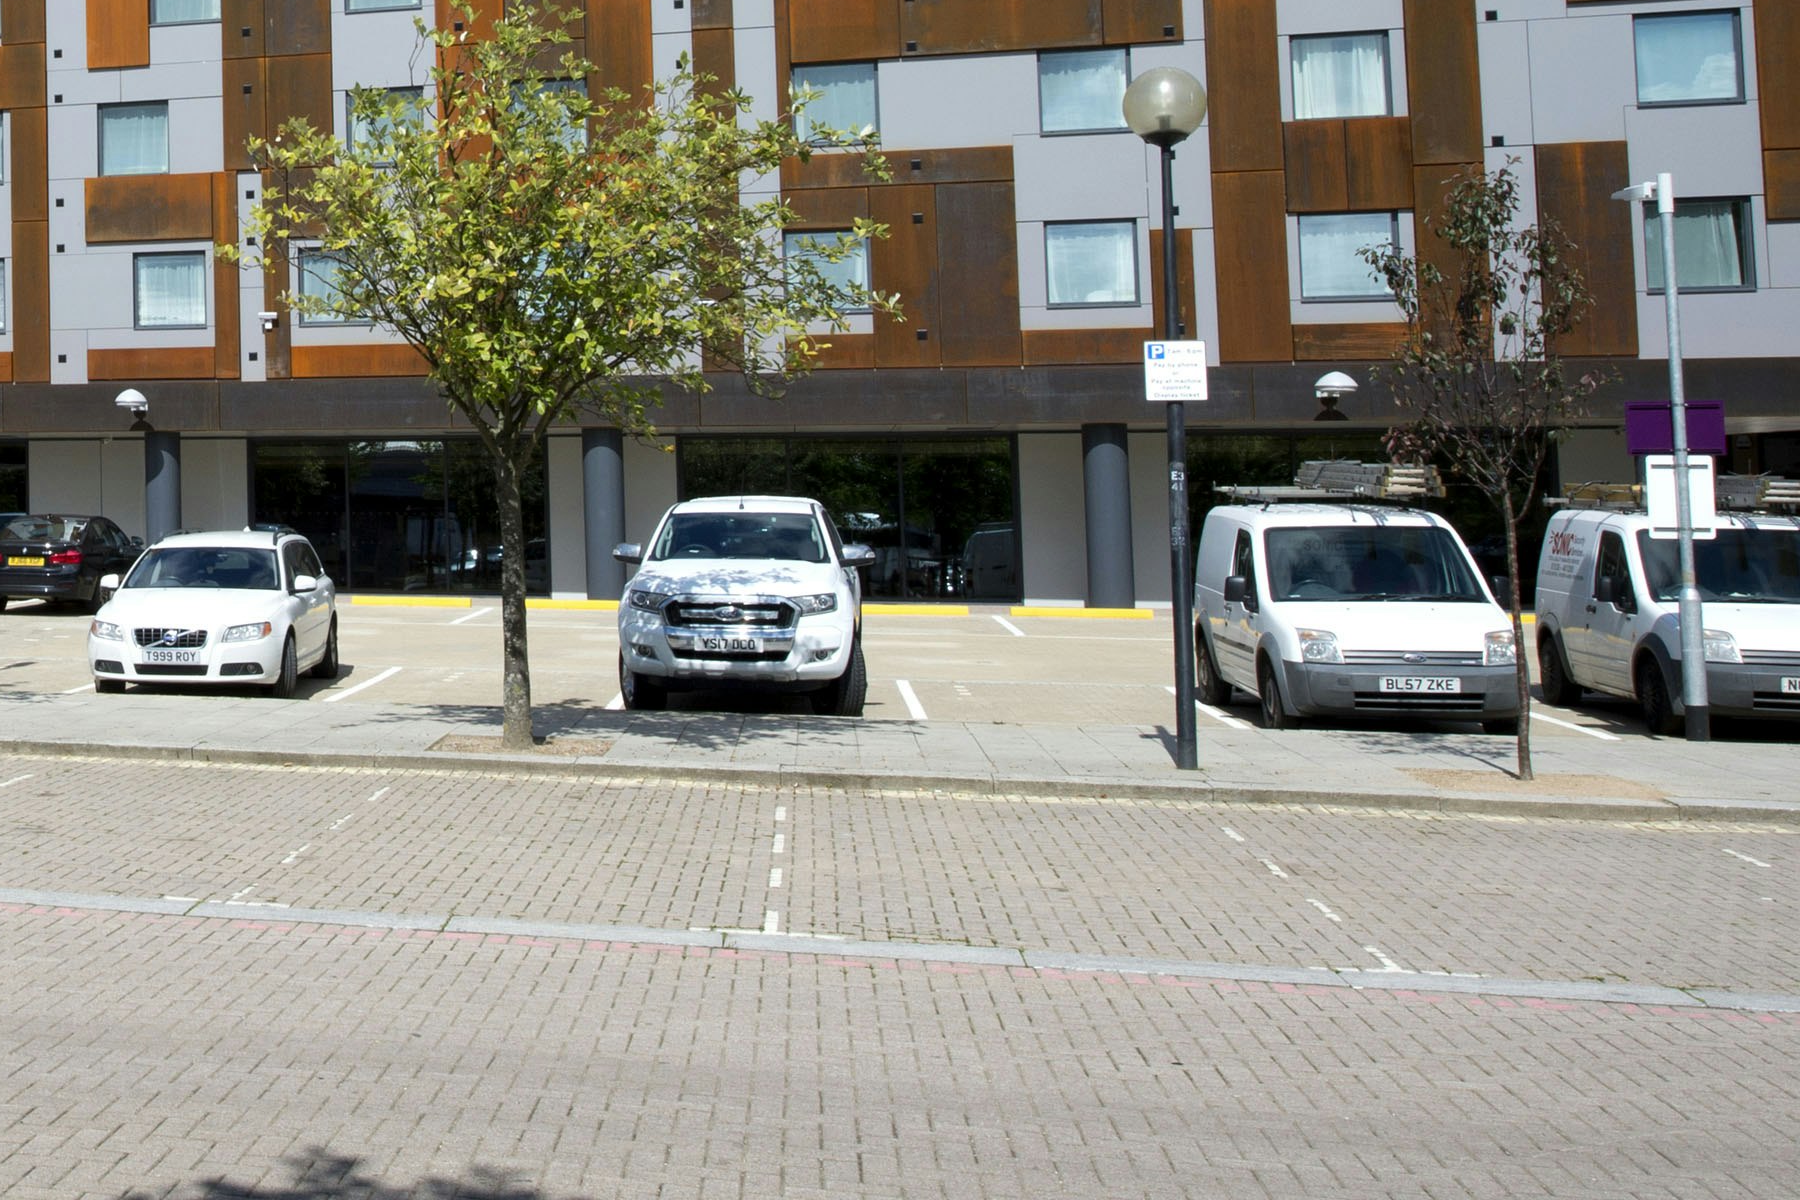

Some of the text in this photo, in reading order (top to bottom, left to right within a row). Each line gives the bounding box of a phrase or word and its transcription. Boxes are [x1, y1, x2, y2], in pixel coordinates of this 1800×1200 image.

[1152, 345, 1163, 359] P
[702, 638, 728, 649] YS17
[146, 651, 196, 662] T999 ROY
[1385, 678, 1455, 691] BL57 ZKE
